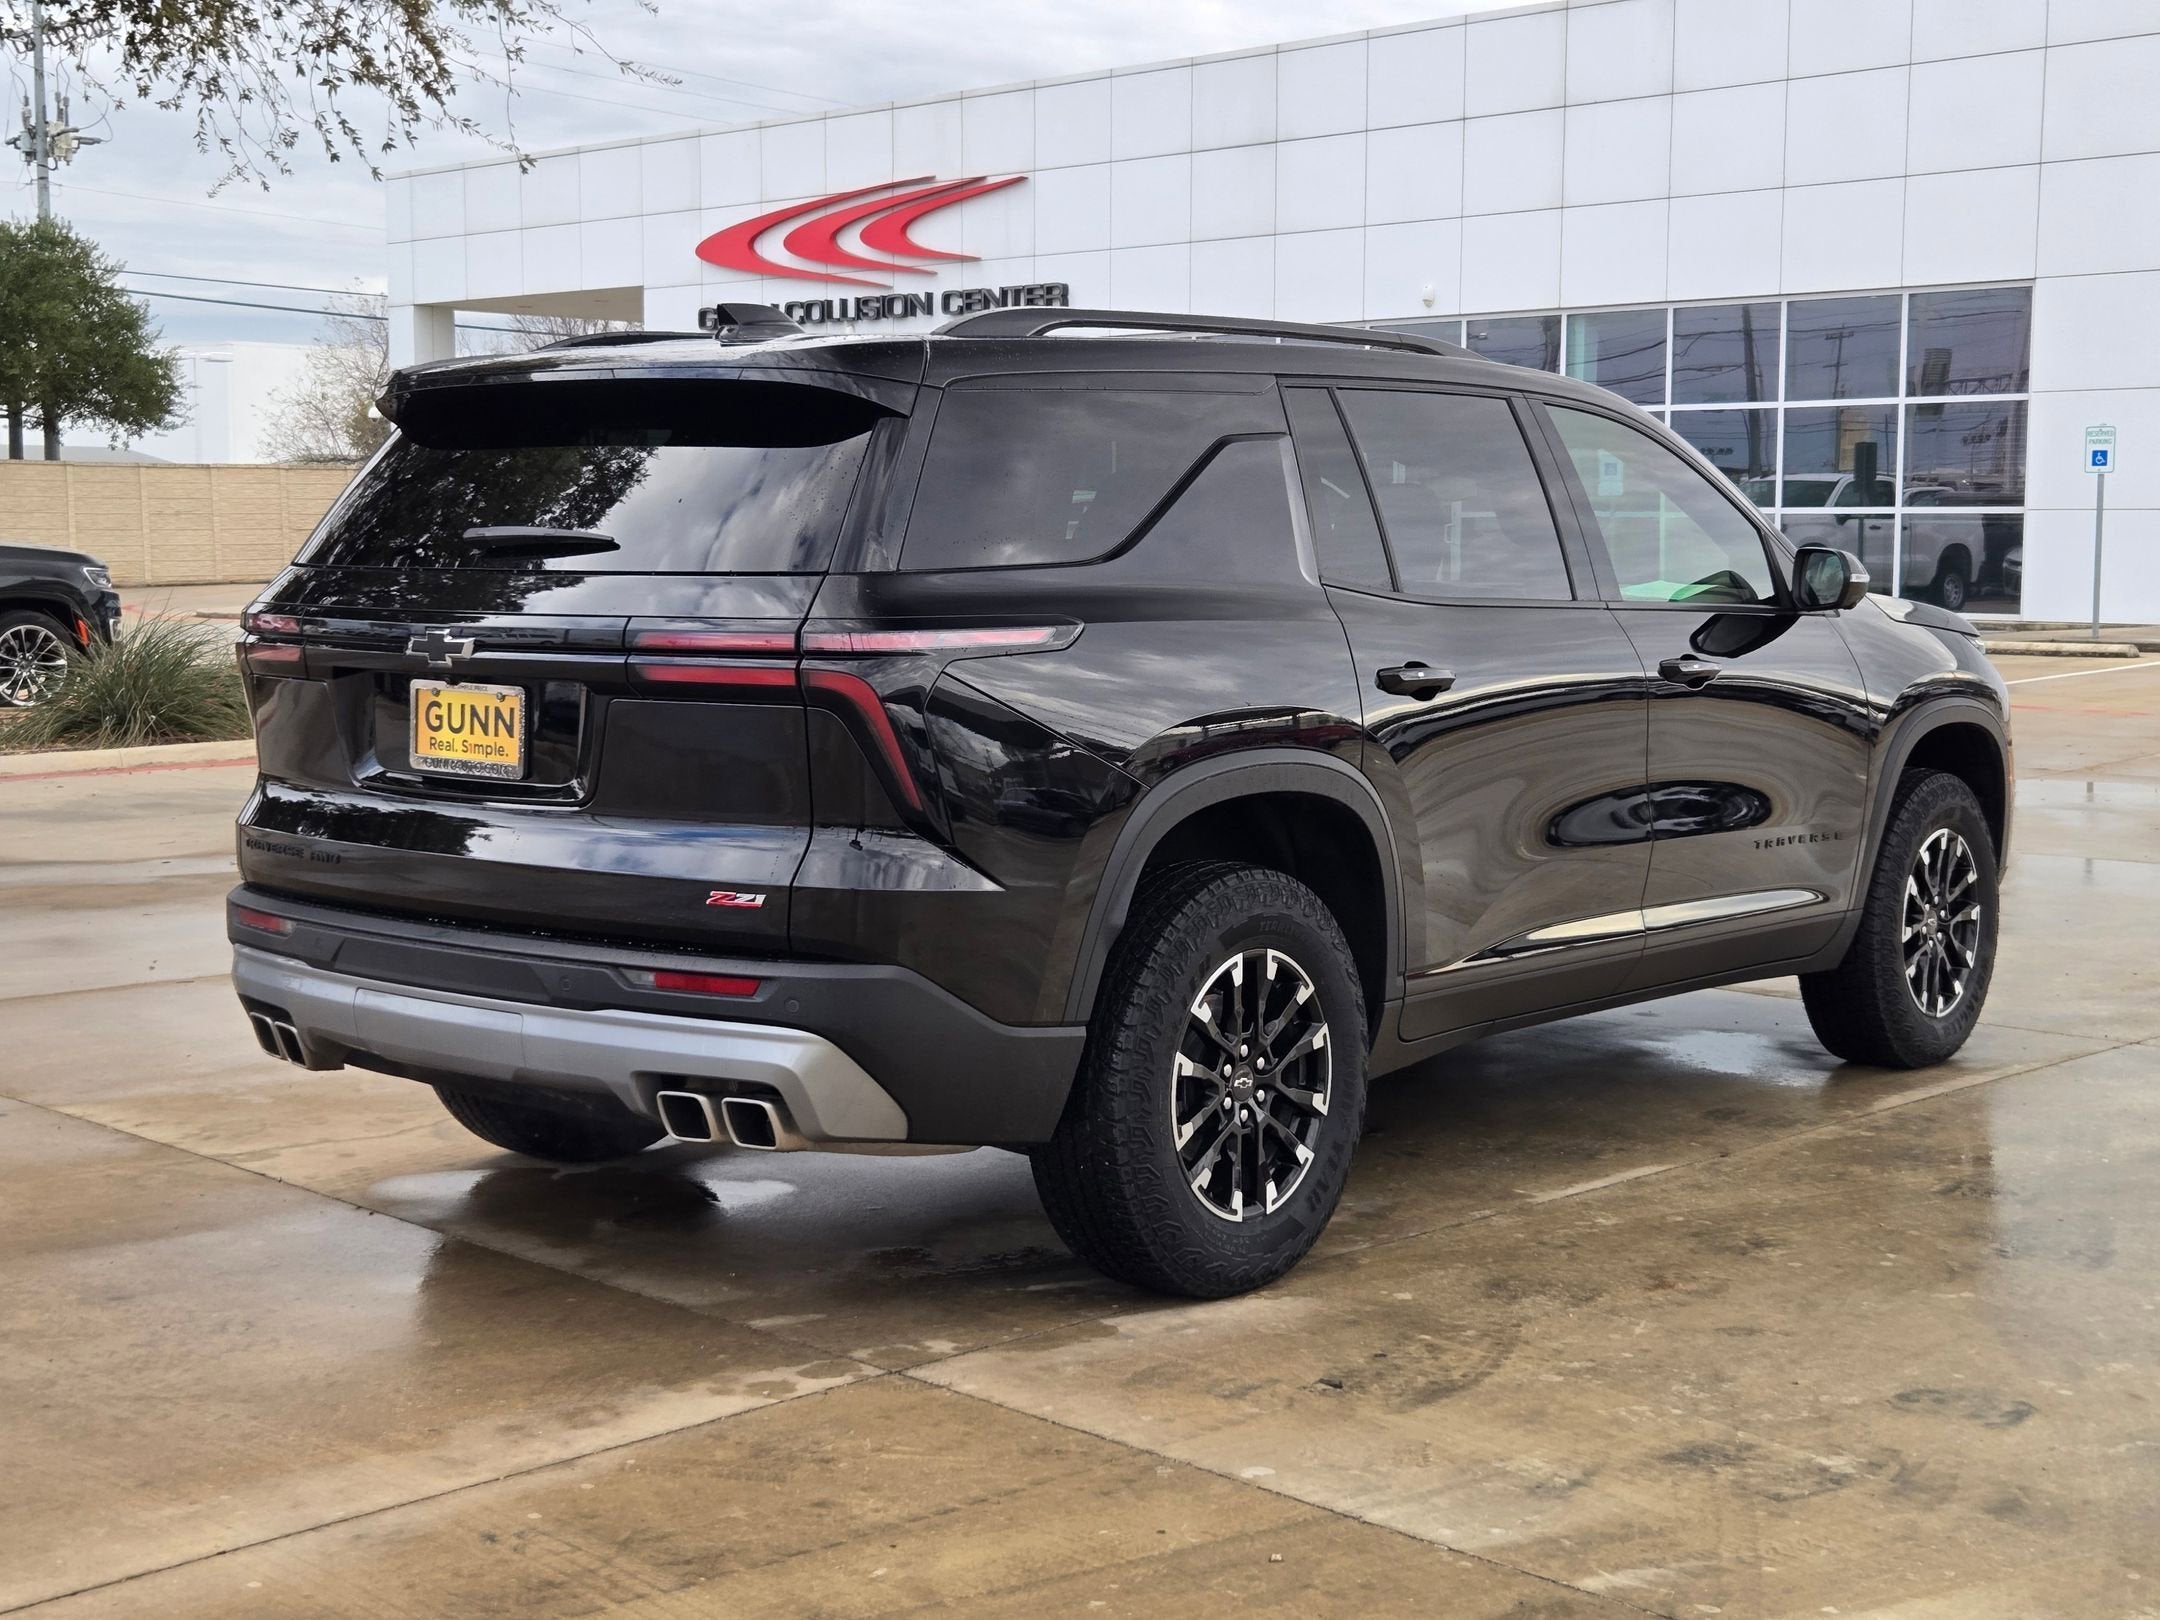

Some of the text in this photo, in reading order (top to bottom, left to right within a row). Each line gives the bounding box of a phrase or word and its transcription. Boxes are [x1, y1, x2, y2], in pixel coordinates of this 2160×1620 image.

[785, 291, 934, 325] COLLISION
[942, 282, 1070, 316] CENTER
[425, 700, 516, 738] GUNN
[429, 736, 458, 752] Real.
[1753, 831, 1842, 849] TRAVERSE
